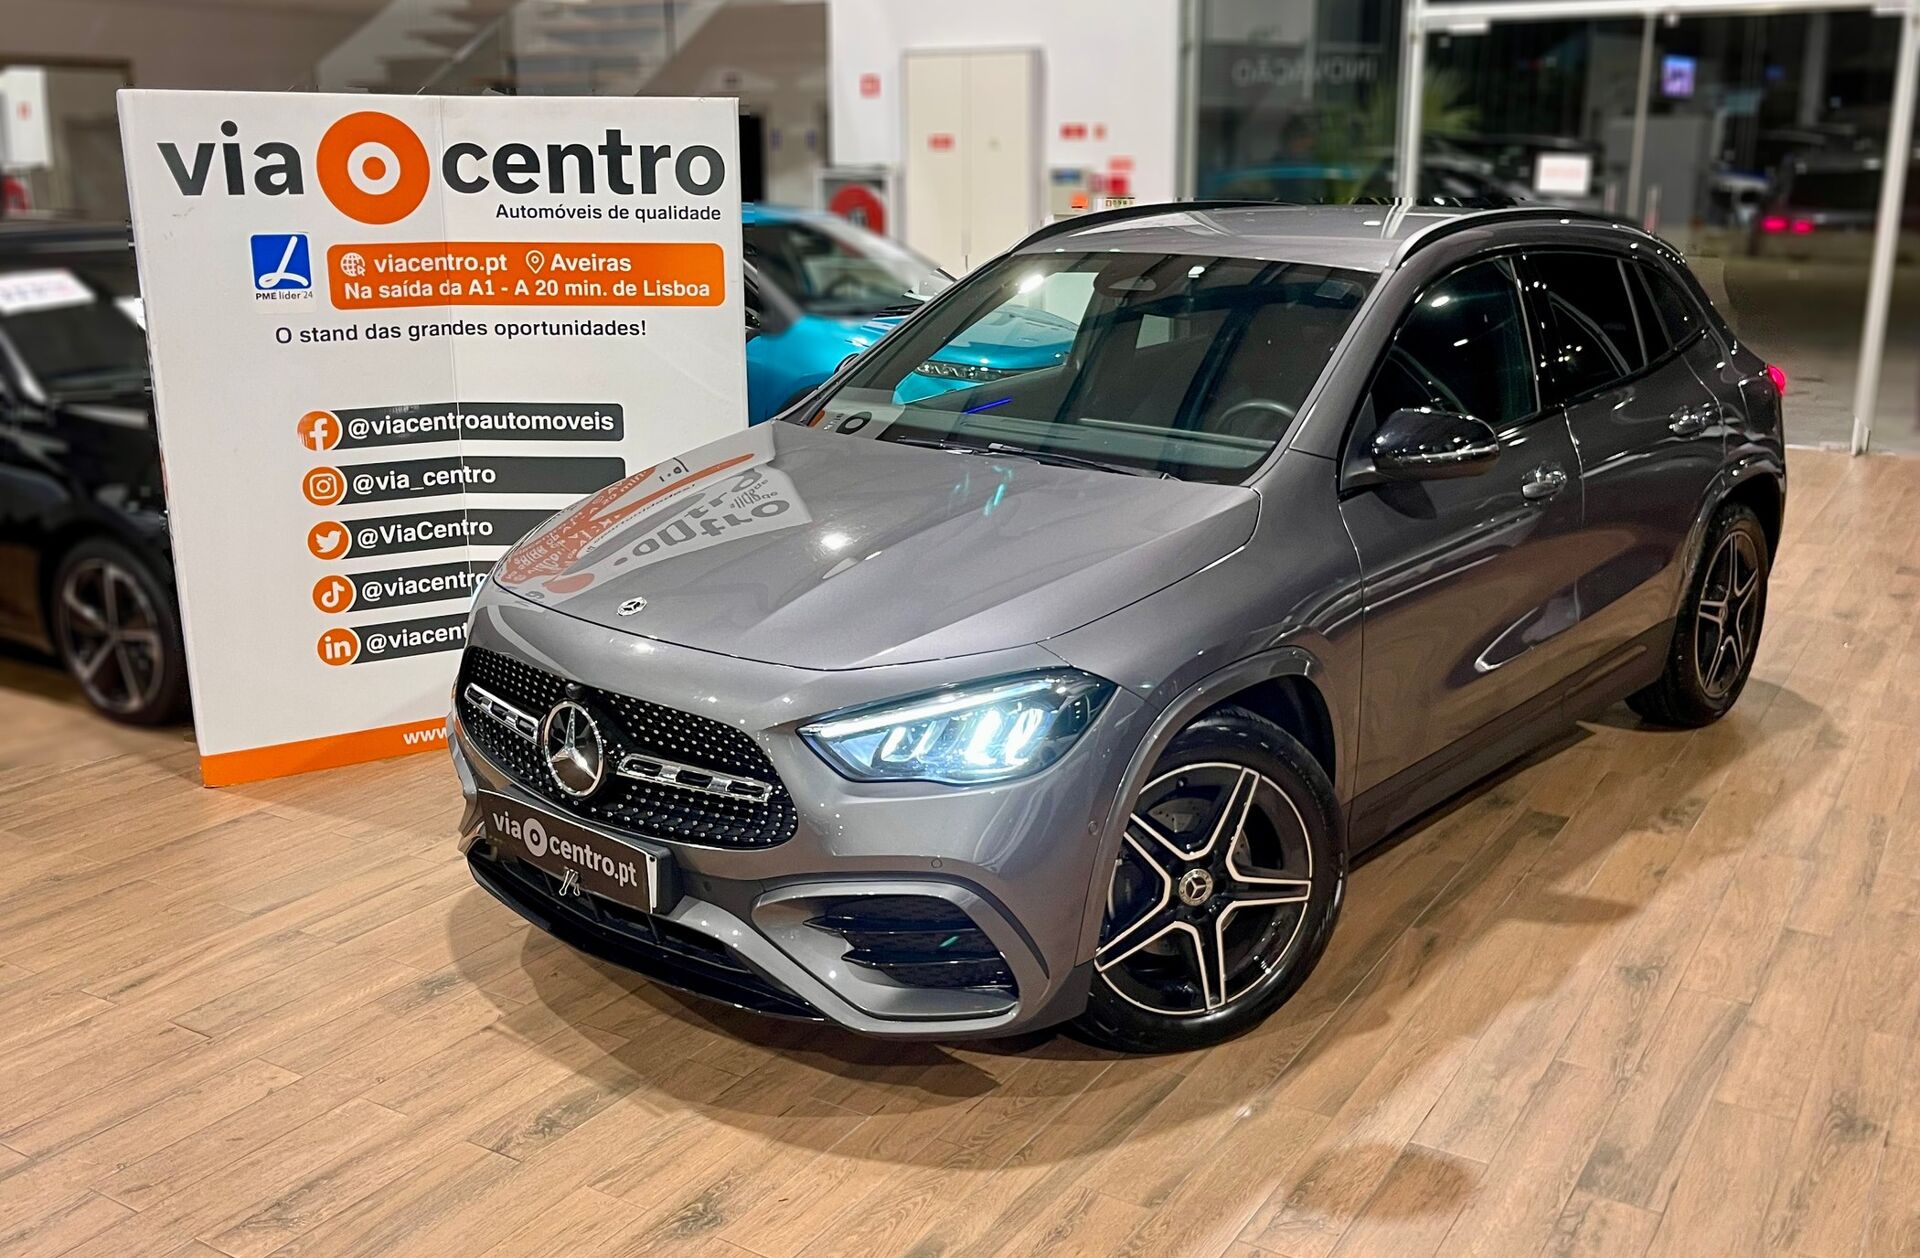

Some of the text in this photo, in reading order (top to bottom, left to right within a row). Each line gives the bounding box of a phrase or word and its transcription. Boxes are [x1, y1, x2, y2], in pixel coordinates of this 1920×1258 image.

[157, 120, 726, 196] via centro
[496, 203, 721, 224] Automóveis de qualidade
[373, 253, 632, 275] viacentro.pt Aveiras
[255, 292, 278, 301] PME
[345, 284, 372, 300] Na
[379, 280, 434, 298] saída
[440, 279, 464, 297] da
[468, 278, 495, 296] A1
[514, 279, 532, 296] A
[536, 279, 560, 296] 20
[565, 279, 608, 297] min.
[613, 279, 637, 297] de
[644, 279, 710, 297] Lisboa
[275, 319, 647, 344] O stand das grandes oportunidades!
[347, 411, 615, 440] @viacentroautomoveis
[352, 466, 497, 496] @via_centro
[357, 519, 494, 549] @ViaCentro
[492, 811, 637, 887] via centro.pt
